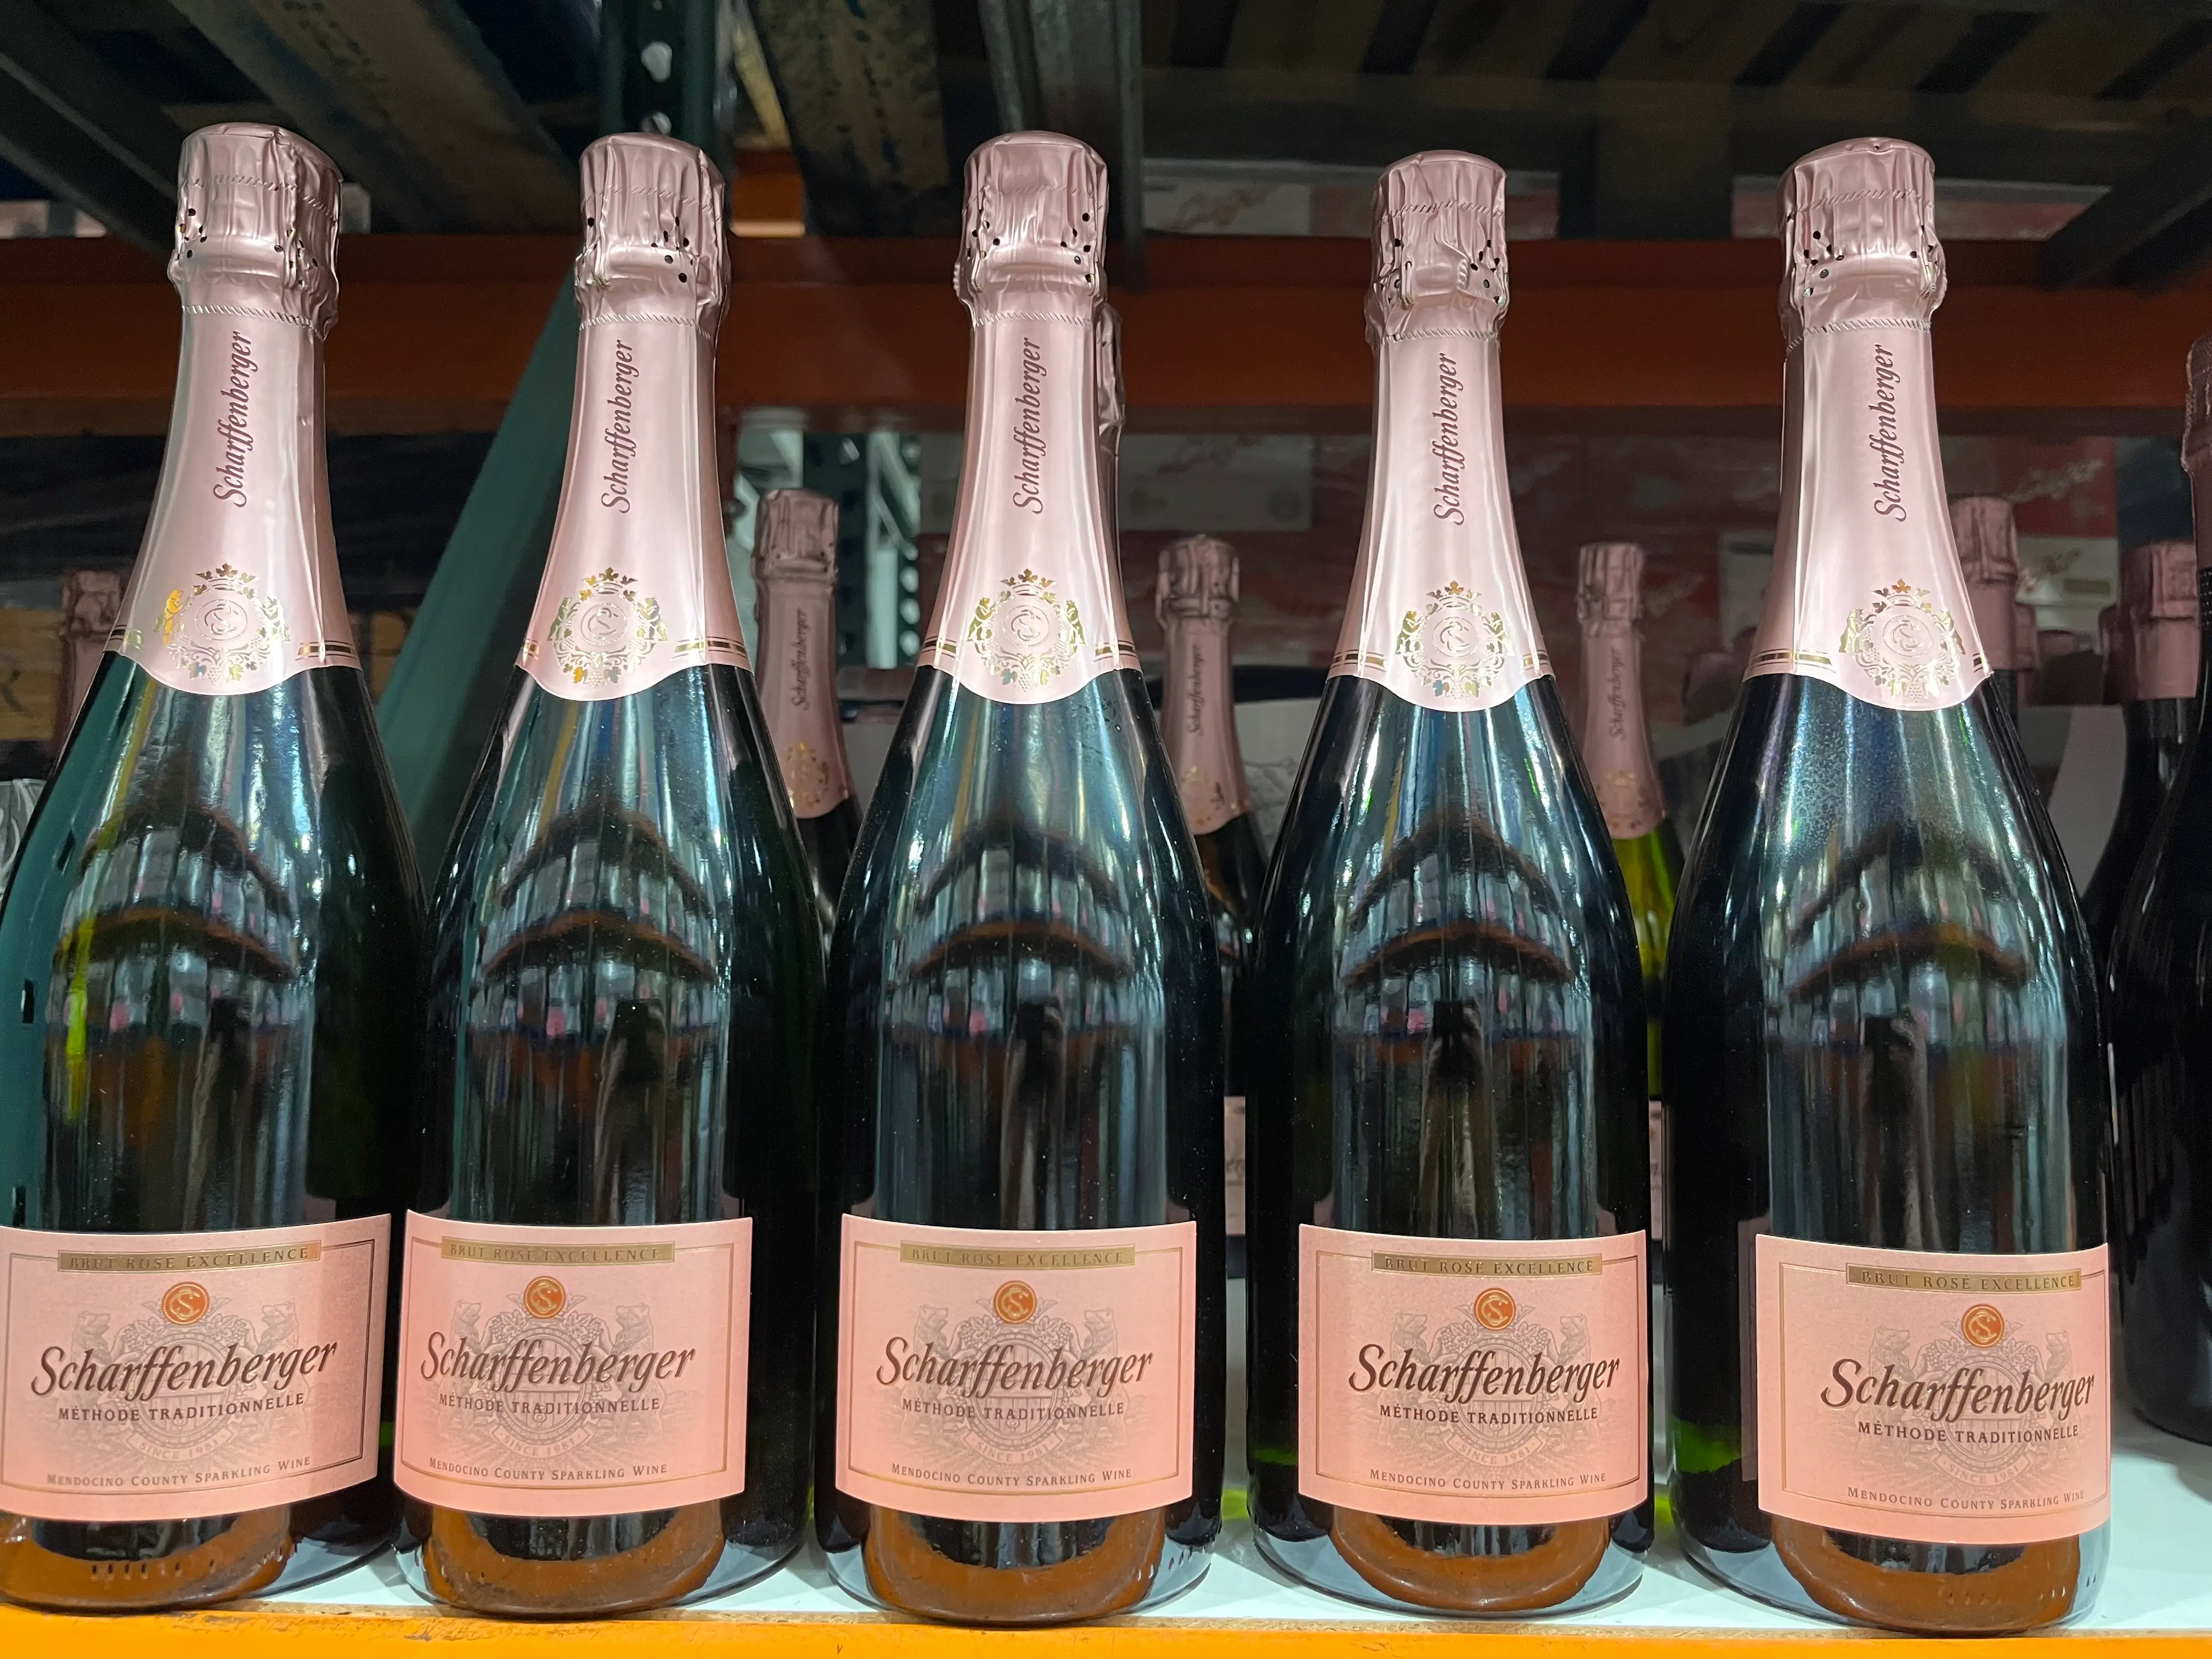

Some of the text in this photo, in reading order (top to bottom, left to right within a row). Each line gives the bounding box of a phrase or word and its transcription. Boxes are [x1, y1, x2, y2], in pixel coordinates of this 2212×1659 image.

[212, 331, 258, 508] Scharffenberger
[601, 339, 640, 514] Scharffenberger
[1012, 337, 1048, 515] Scharffenberger
[1432, 352, 1465, 526] Scharffenberger
[1871, 343, 1907, 522] Scharffenberger
[71, 1256, 114, 1269] BRUT
[187, 1247, 309, 1268] EXCELLENCE
[450, 1244, 484, 1257] BRUT
[545, 1248, 661, 1262] EXCELLENCE
[912, 1249, 951, 1262] BRUT
[1016, 1251, 1124, 1266] EXCELLENCE
[1385, 1257, 1429, 1271] BRUT
[1494, 1261, 1593, 1274] EXCELLENCE
[1861, 1270, 1911, 1286] BRUT
[1982, 1276, 2074, 1290] EXCELLENCE
[31, 1341, 337, 1402] Scharffenberger
[420, 1331, 696, 1392] Scharffenberger
[877, 1336, 1153, 1398] Scharffenberger
[1349, 1344, 1620, 1404] Scharffenberger
[1820, 1358, 2095, 1423] Scharffenberger
[149, 1393, 304, 1420] TRADITIONNELLE
[512, 1397, 660, 1414] TRADITIONNELLE
[984, 1402, 1124, 1420] TRADITIONNELLE
[1468, 1407, 1598, 1424] TRADITIONNELLE
[1955, 1424, 2078, 1443] TRADITIONNELLE
[139, 1440, 220, 1459] SINCE 1981
[503, 1437, 577, 1455] SINCE 1981
[975, 1440, 1048, 1461] SINCE 1981
[1461, 1446, 1532, 1465] SINCE 1981
[1948, 1464, 2020, 1483] SINCE 1981
